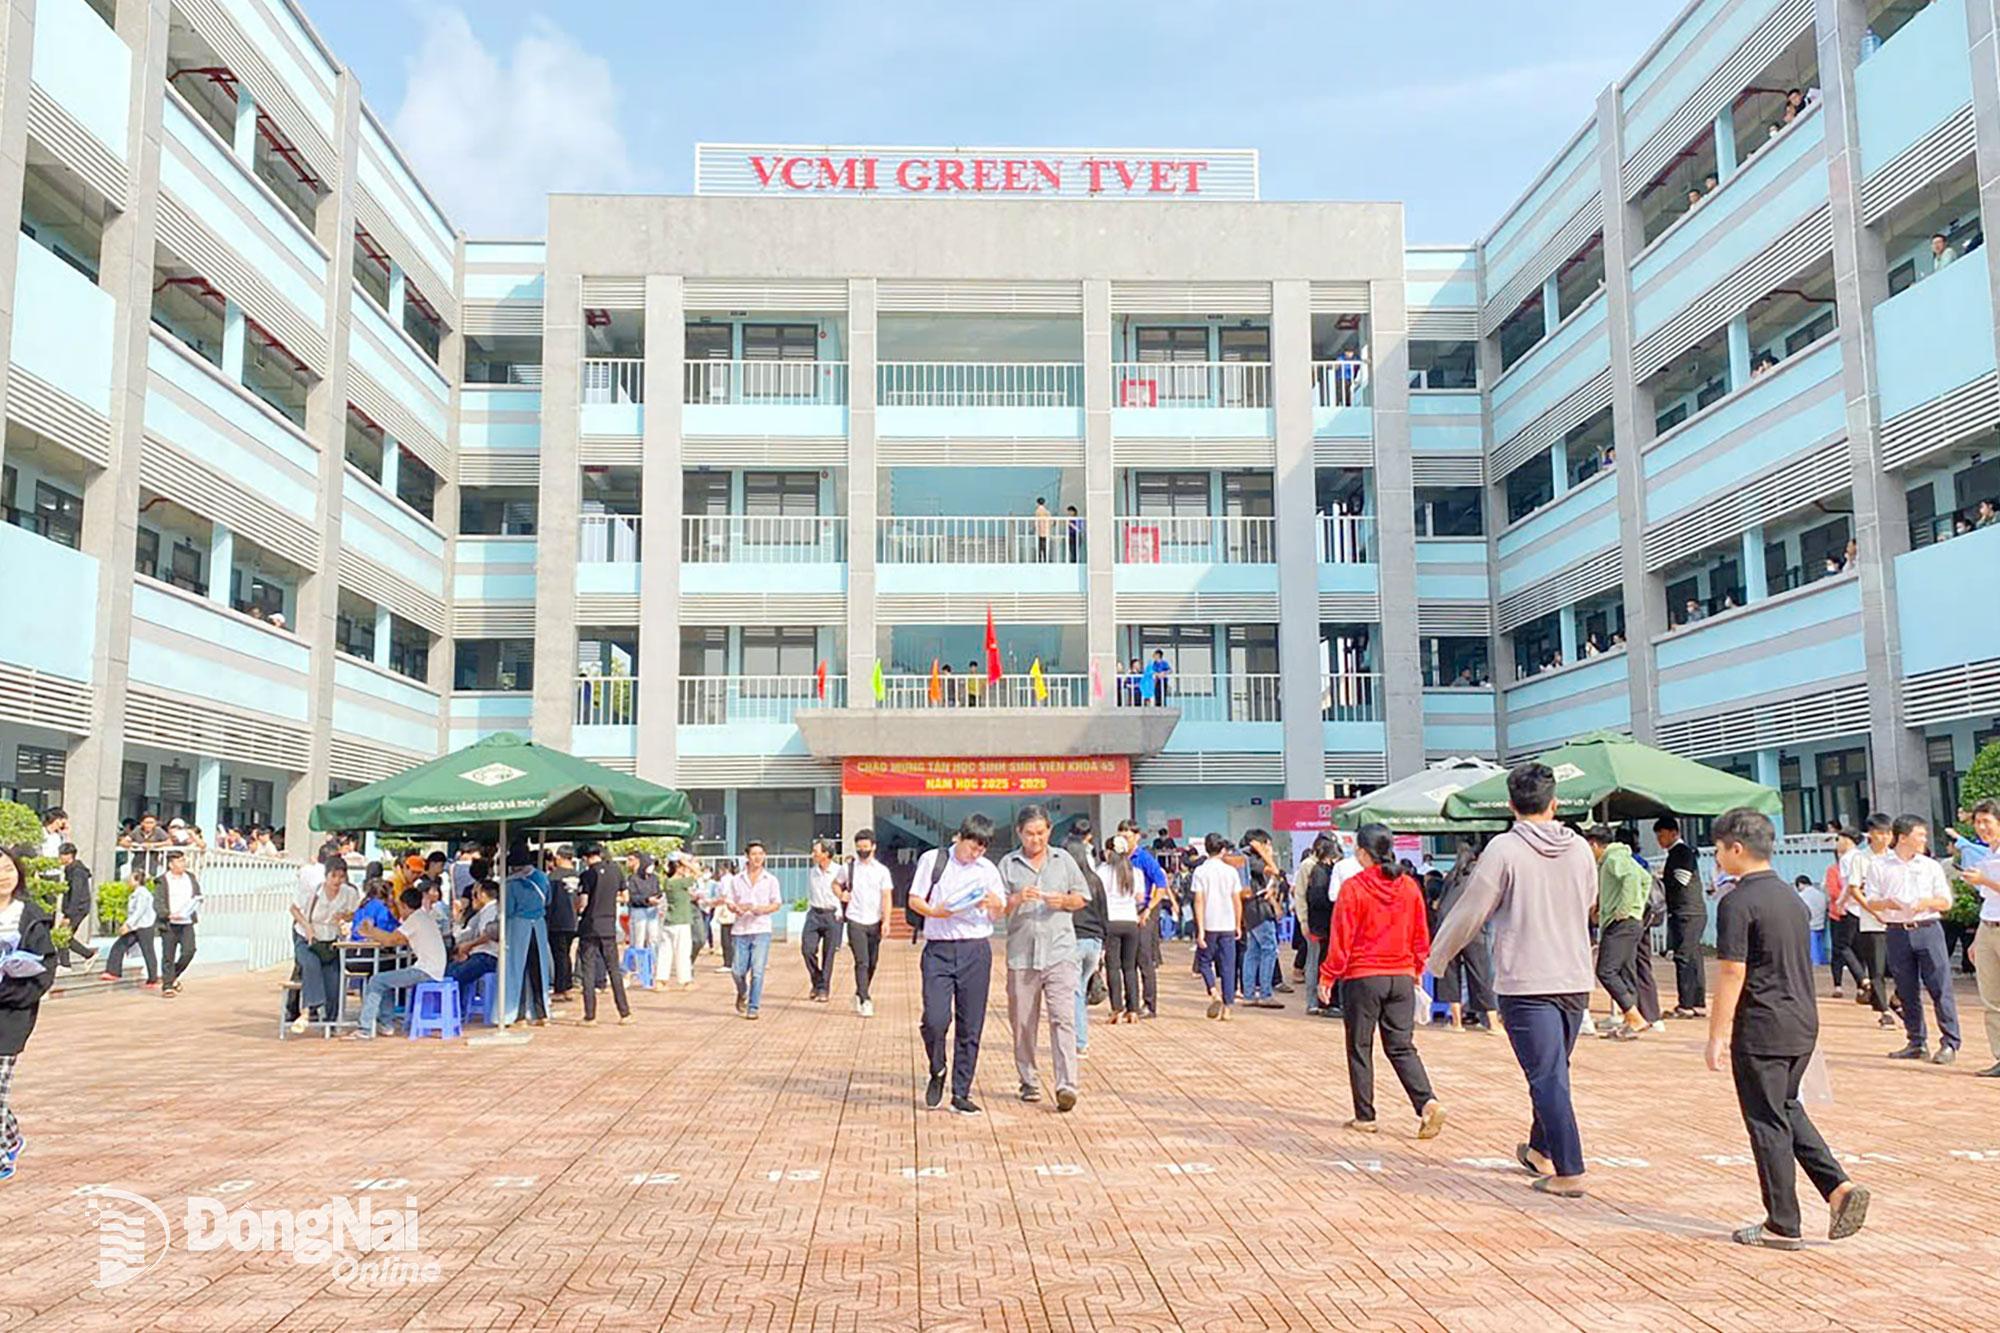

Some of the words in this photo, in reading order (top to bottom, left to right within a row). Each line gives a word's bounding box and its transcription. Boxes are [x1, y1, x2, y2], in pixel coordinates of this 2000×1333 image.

[748, 156, 879, 190] VCMI
[895, 158, 1063, 192] GREEN
[1080, 159, 1208, 193] TVET
